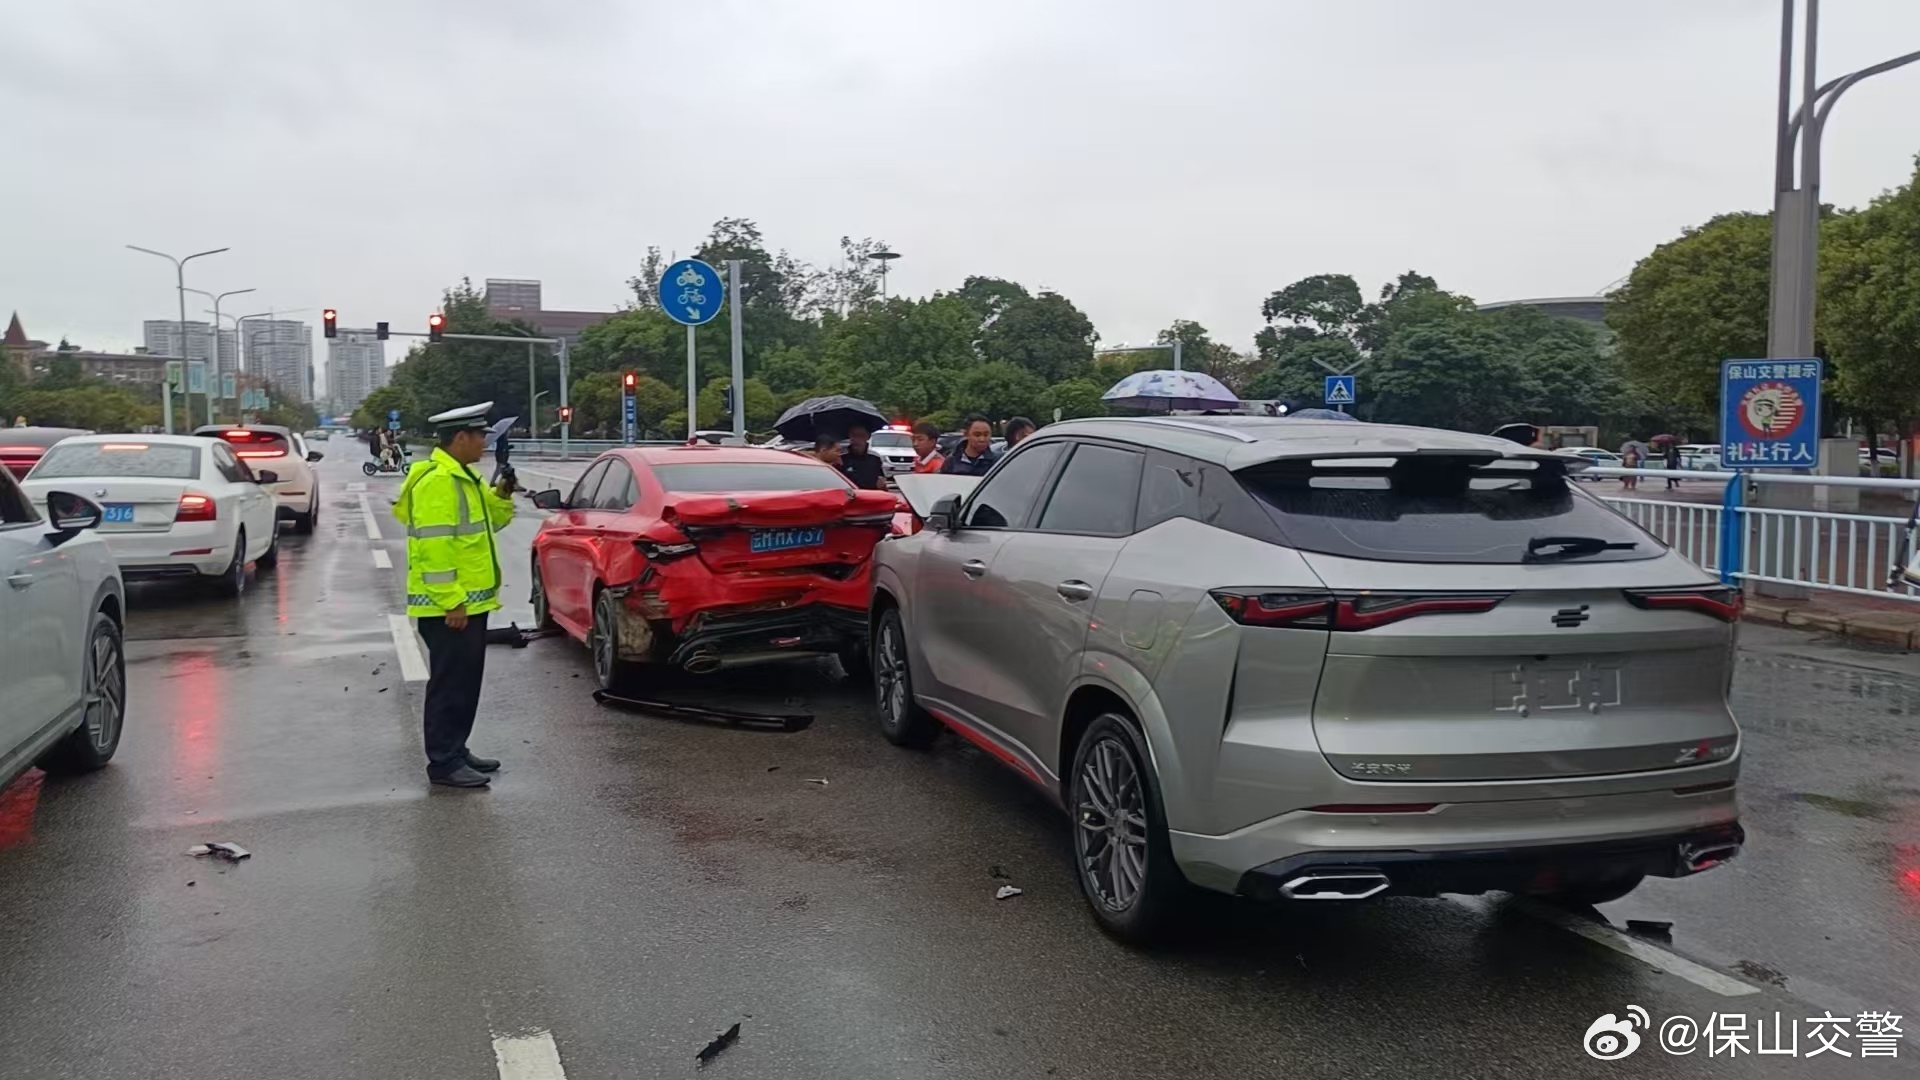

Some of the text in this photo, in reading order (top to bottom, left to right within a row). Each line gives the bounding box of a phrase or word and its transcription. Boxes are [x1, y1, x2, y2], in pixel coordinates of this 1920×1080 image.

[1728, 364, 1817, 379] 保山交警提示
[1727, 442, 1813, 461] 礼让行人
